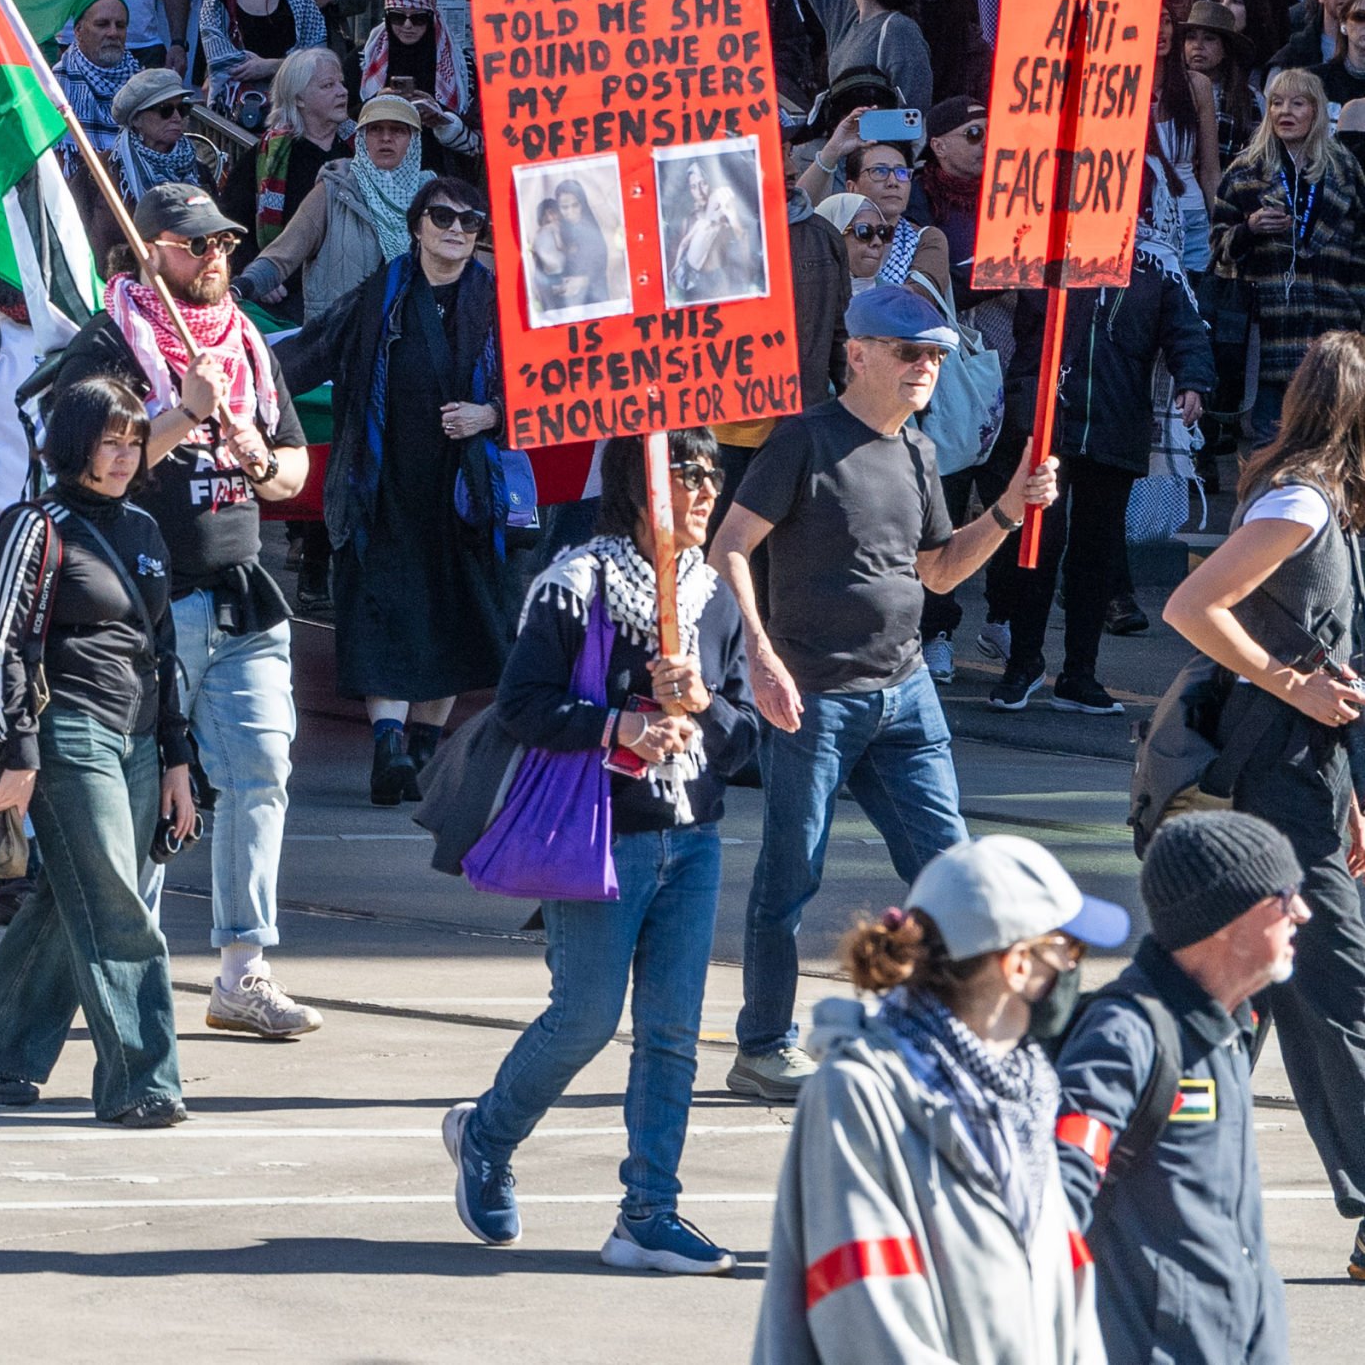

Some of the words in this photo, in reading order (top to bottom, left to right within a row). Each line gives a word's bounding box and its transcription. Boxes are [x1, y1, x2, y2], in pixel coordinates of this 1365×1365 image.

[484, 8, 579, 44] TOLD
[482, 38, 610, 85] FOUND
[625, 35, 700, 69] ONE
[717, 30, 761, 64] OF
[508, 84, 567, 119] MY
[601, 65, 766, 107] POSTERS
[568, 321, 603, 354] IS
[633, 305, 724, 344] THIS
[514, 390, 667, 450] ENOUGH
[678, 380, 725, 424] FOR
[734, 376, 800, 417] YOU?
[33, 614, 44, 634] EOS
[39, 570, 54, 612] DIGITAL
